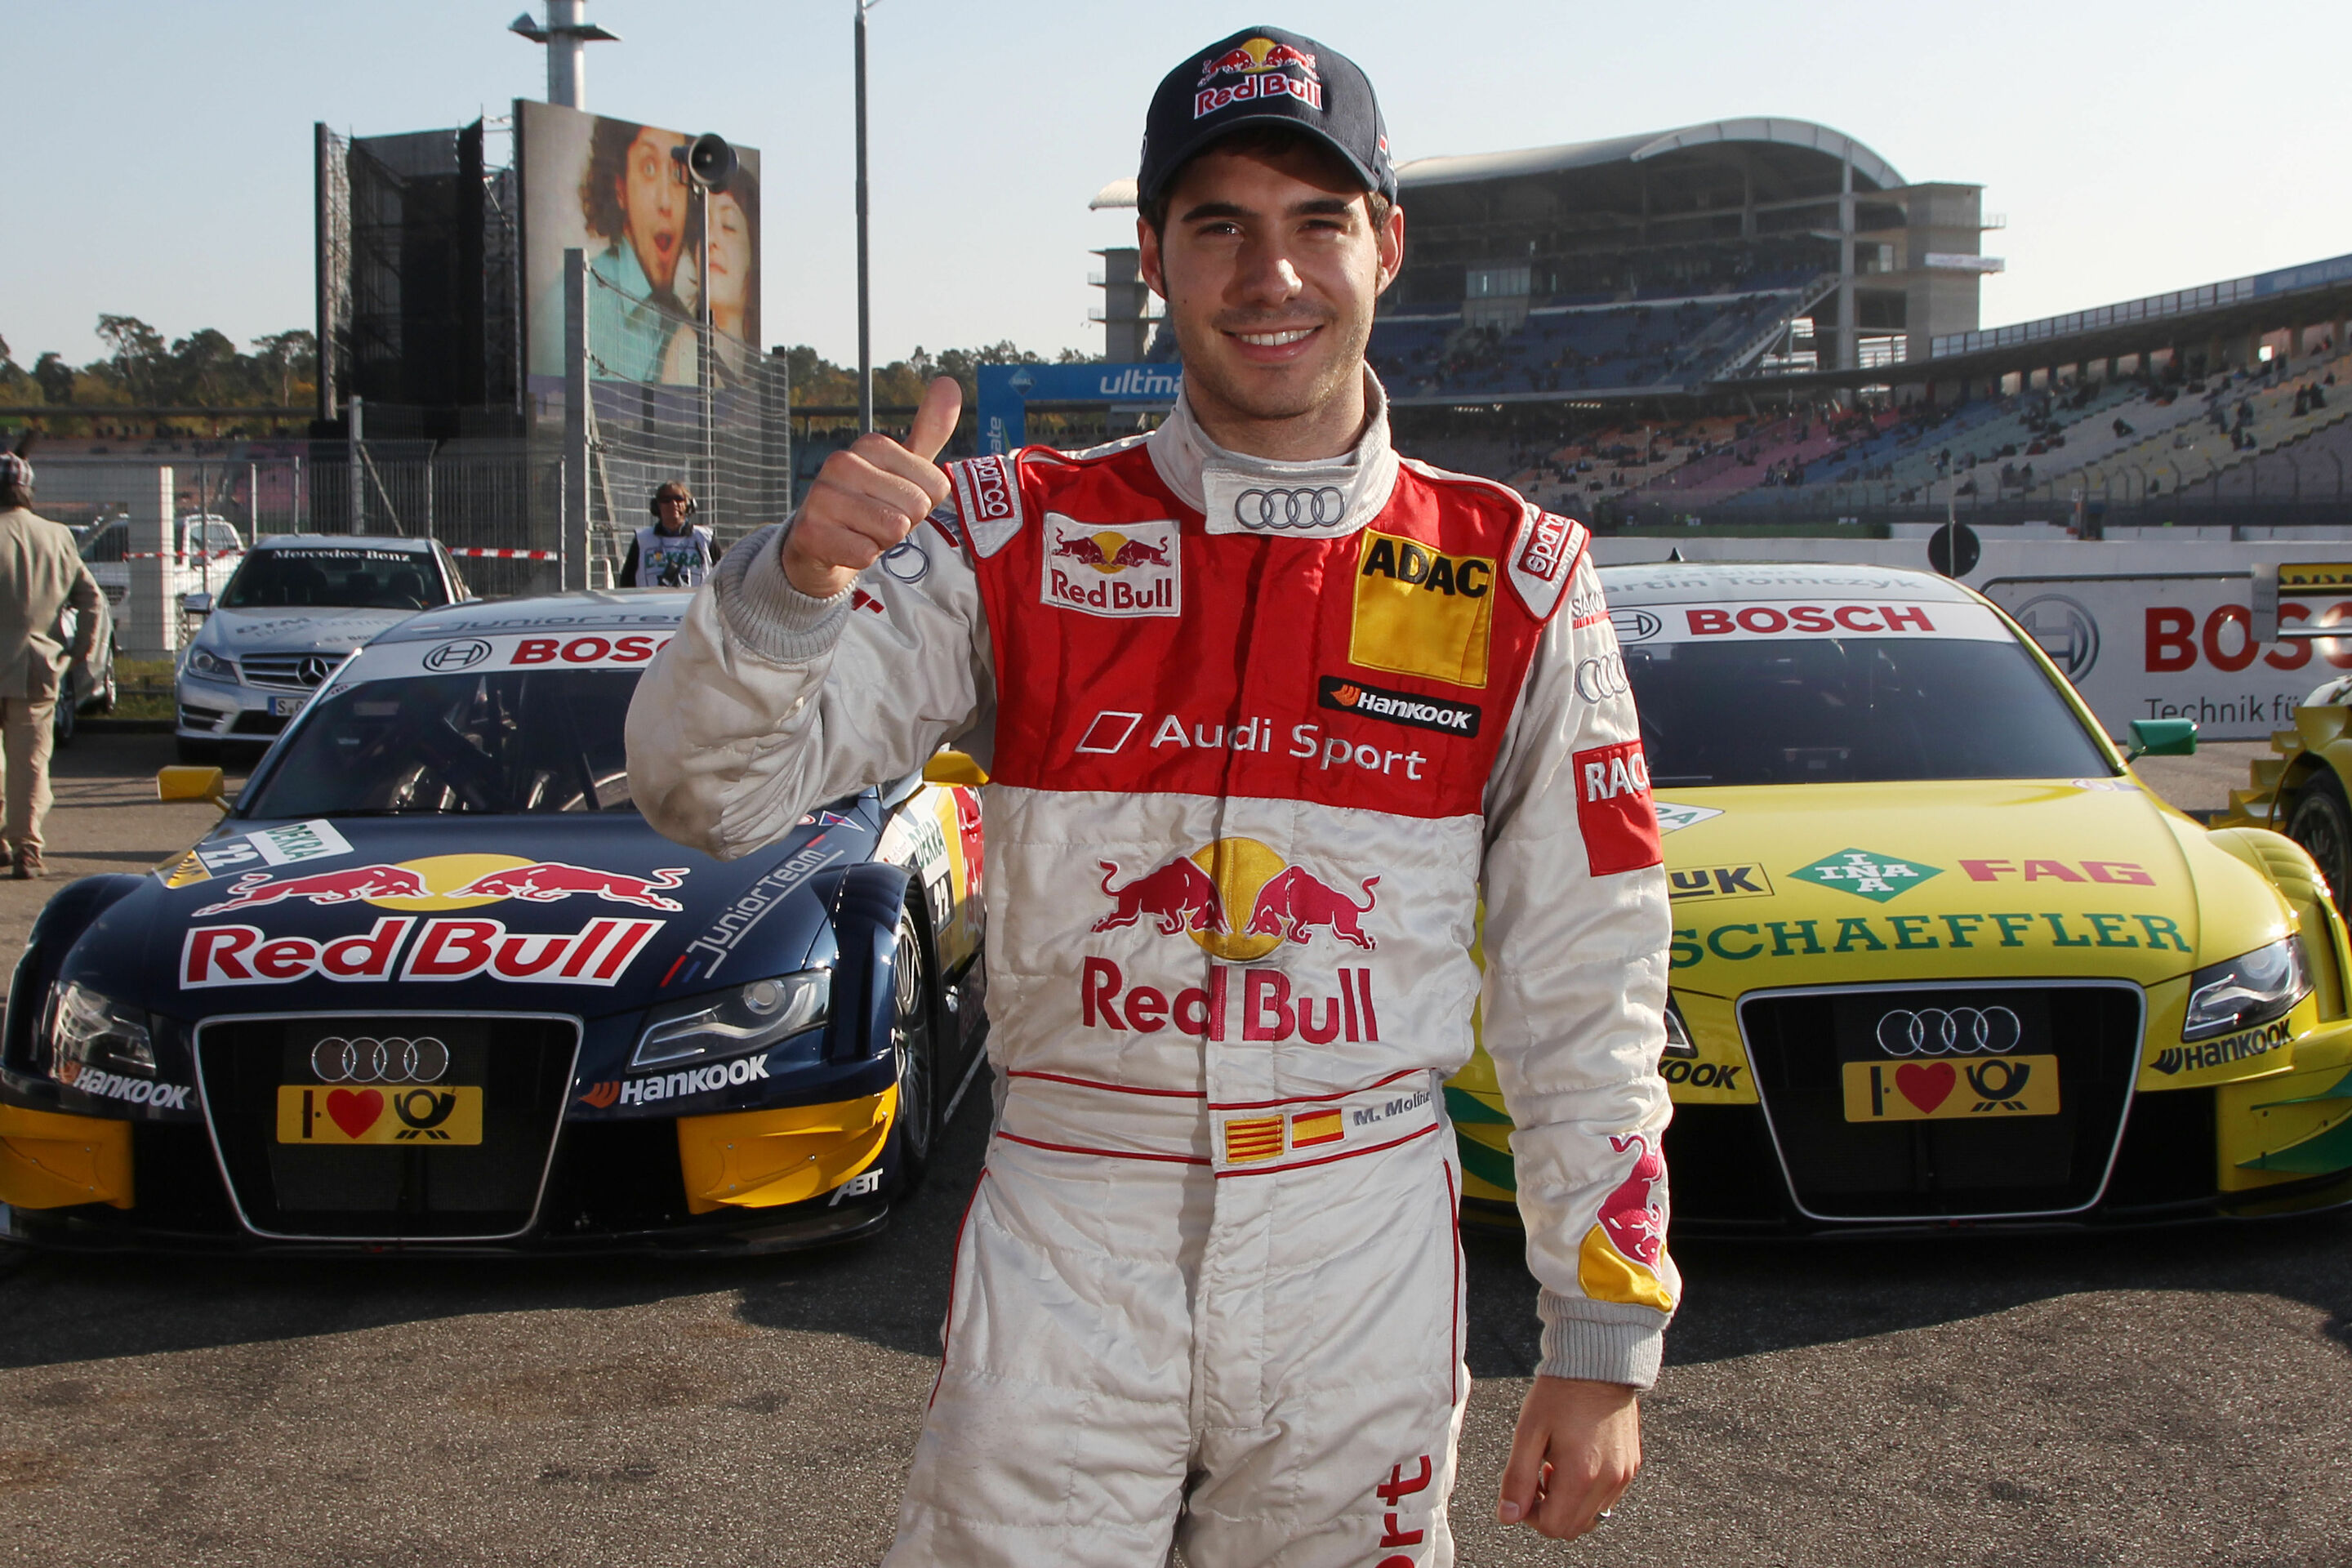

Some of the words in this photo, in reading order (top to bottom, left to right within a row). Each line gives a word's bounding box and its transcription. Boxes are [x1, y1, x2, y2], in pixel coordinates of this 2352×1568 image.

[1194, 74, 1258, 119] Red
[1259, 73, 1323, 111] Bull
[272, 549, 411, 562] Mercedes-Benz
[1361, 539, 1490, 598] ADAC
[1052, 569, 1106, 608] Red
[1112, 578, 1172, 608] Bull
[1604, 579, 1708, 594] artin
[1718, 576, 1925, 589] Tomczyk
[1686, 606, 1936, 635] BOSCH
[509, 636, 673, 665] BOS
[2145, 695, 2265, 723] Technik
[2273, 695, 2297, 722] fü
[1150, 715, 1272, 752] Audi
[1290, 724, 1428, 781] Sport
[265, 824, 328, 861] DEKRA
[1958, 858, 2156, 886] FAG
[933, 876, 950, 924] 22
[182, 918, 413, 988] Red
[403, 919, 663, 986] Bull
[1670, 912, 2193, 969] SCHAEFFLER
[1082, 956, 1228, 1041] Red
[1242, 969, 1379, 1045] Bull
[1353, 1107, 1381, 1126] M.
[828, 1168, 884, 1206] ABT
